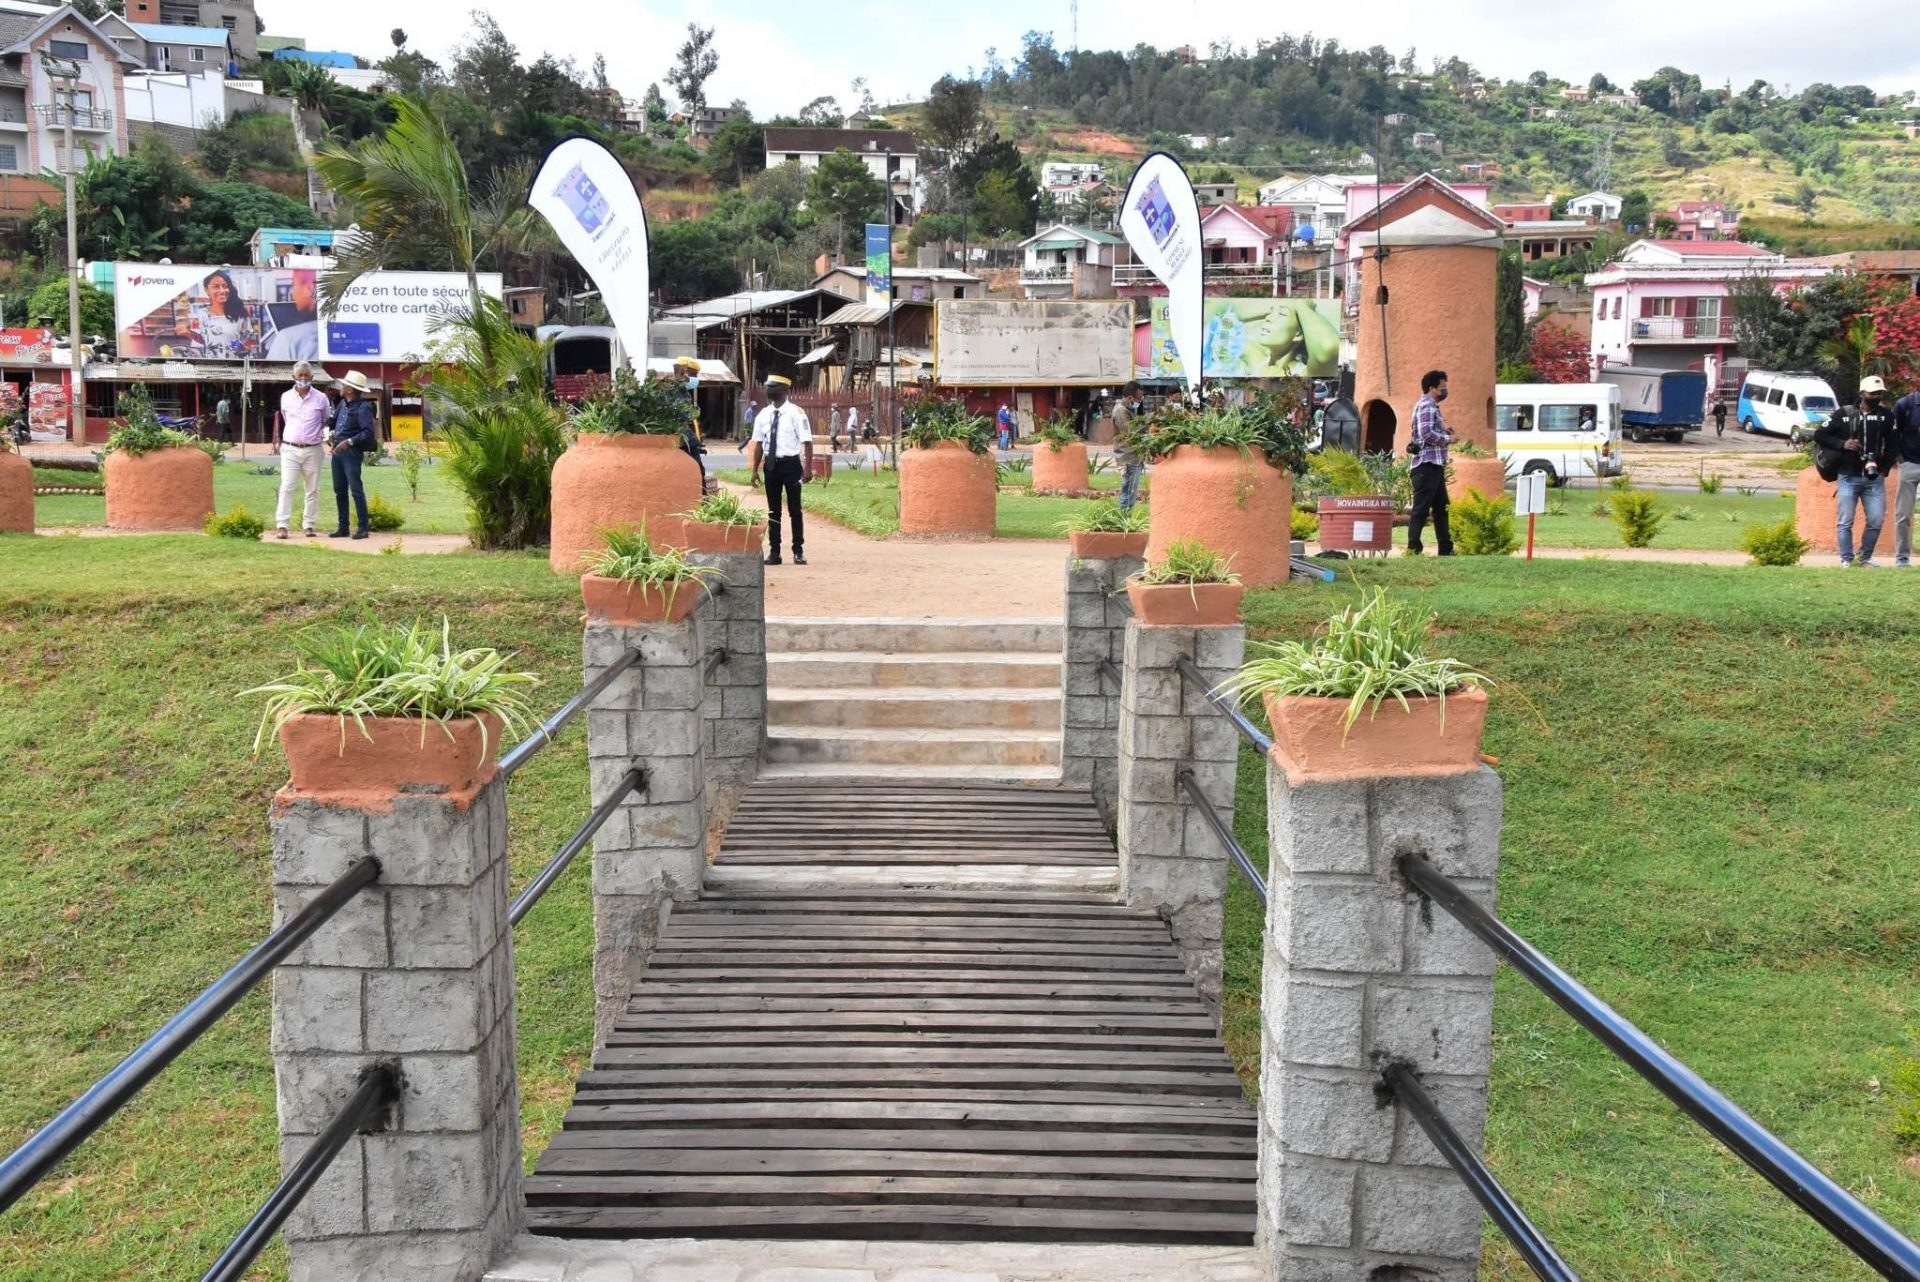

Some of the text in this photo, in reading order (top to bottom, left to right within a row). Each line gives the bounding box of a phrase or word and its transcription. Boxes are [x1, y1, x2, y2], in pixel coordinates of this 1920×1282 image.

[142, 277, 175, 286] jovena
[344, 285, 486, 298] yez en toute sécuré
[336, 303, 359, 313] vec
[363, 302, 398, 313] votre
[402, 303, 436, 314] carte
